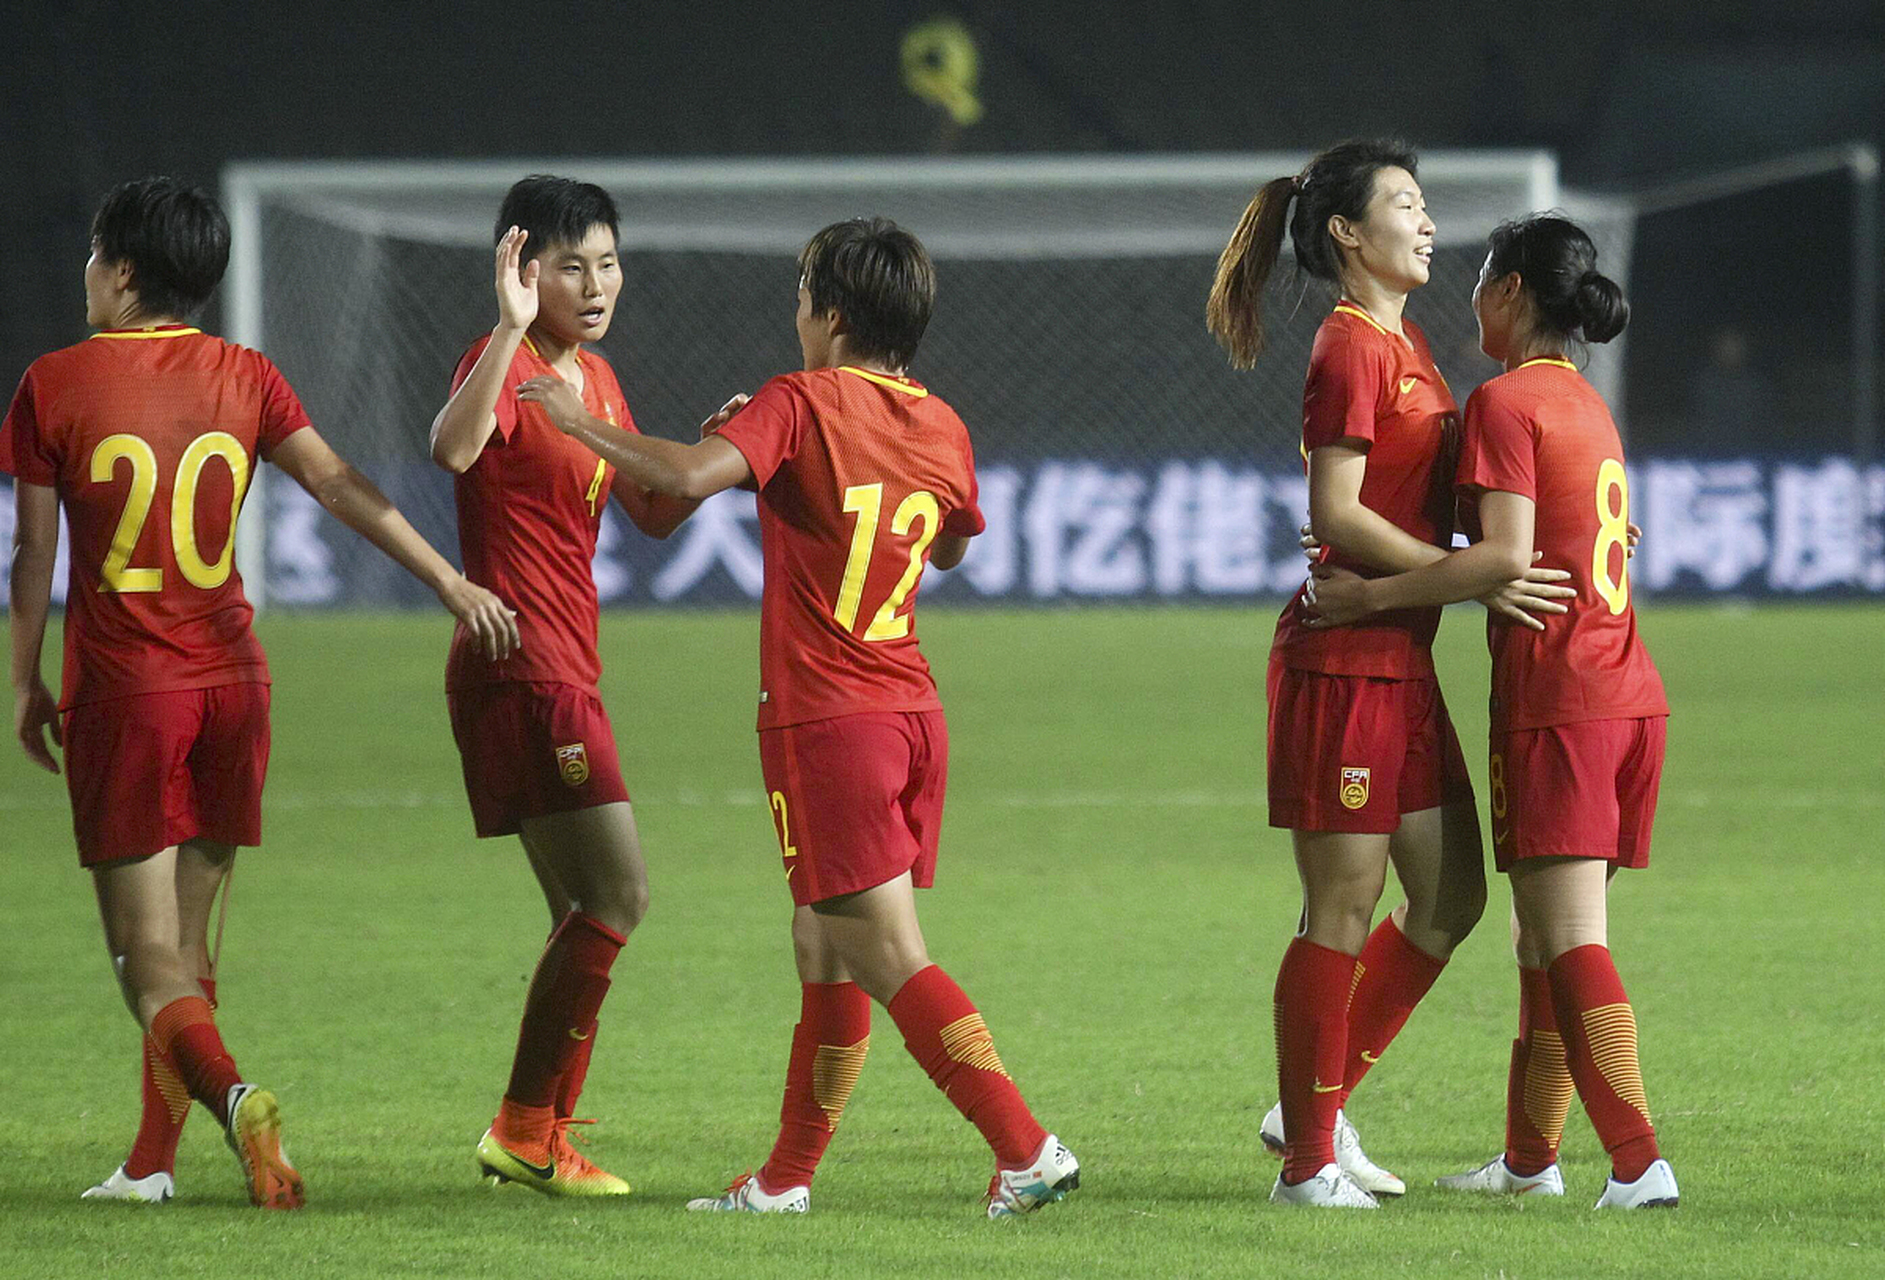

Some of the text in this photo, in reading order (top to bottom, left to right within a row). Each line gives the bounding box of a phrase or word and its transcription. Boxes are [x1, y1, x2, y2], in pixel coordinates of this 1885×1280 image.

[90, 431, 250, 593] 20
[833, 482, 940, 641] 12
[1592, 458, 1629, 615] 8
[1490, 754, 1507, 819] 8
